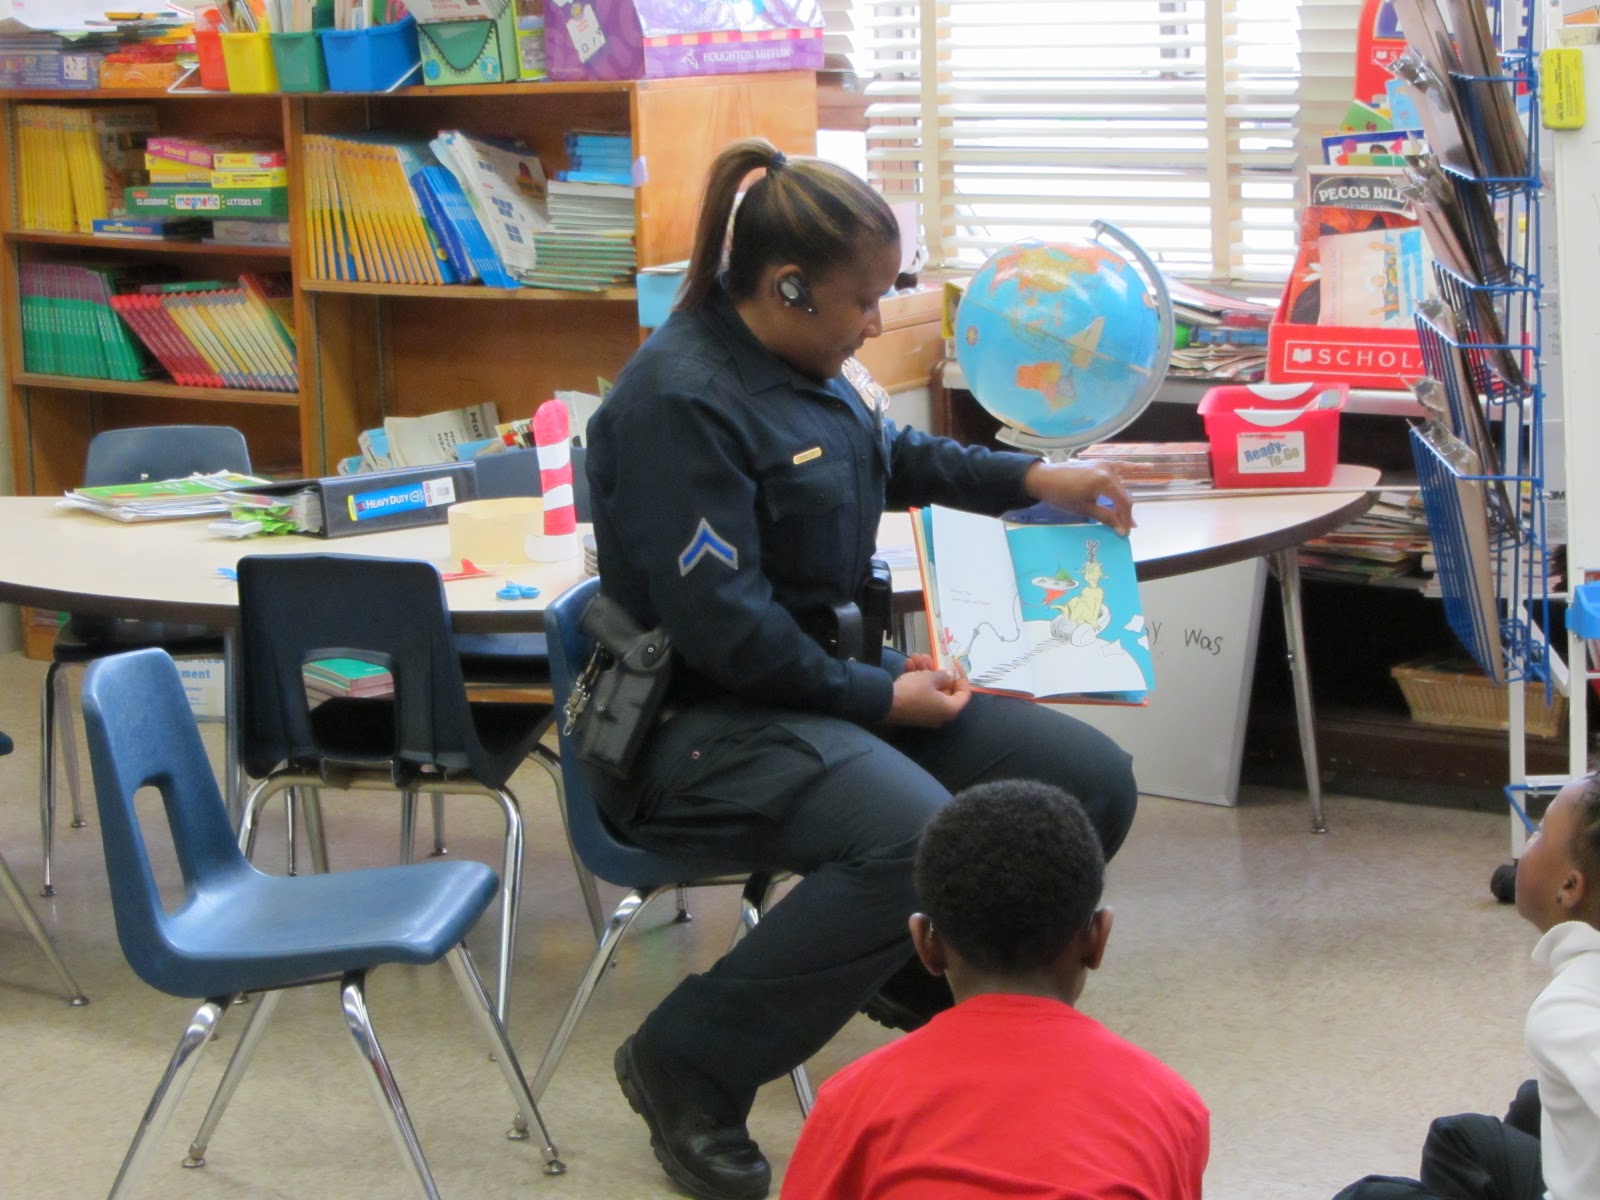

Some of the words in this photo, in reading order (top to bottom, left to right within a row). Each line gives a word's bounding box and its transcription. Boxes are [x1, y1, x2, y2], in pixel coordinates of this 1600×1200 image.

[703, 50, 754, 62] HOUGHTON
[755, 47, 791, 59] MIFFLIN
[137, 198, 169, 206] CLASSROOM
[177, 195, 219, 210] magnetic
[253, 198, 263, 207] KIT
[1318, 186, 1371, 202] PECOS
[1373, 186, 1406, 203] BILL
[1244, 441, 1286, 463] Ready-
[1266, 447, 1300, 468] To-Go
[366, 499, 390, 510] HEAVY
[390, 494, 409, 506] DUTY
[1184, 628, 1224, 656] Was
[180, 669, 211, 680] ment
